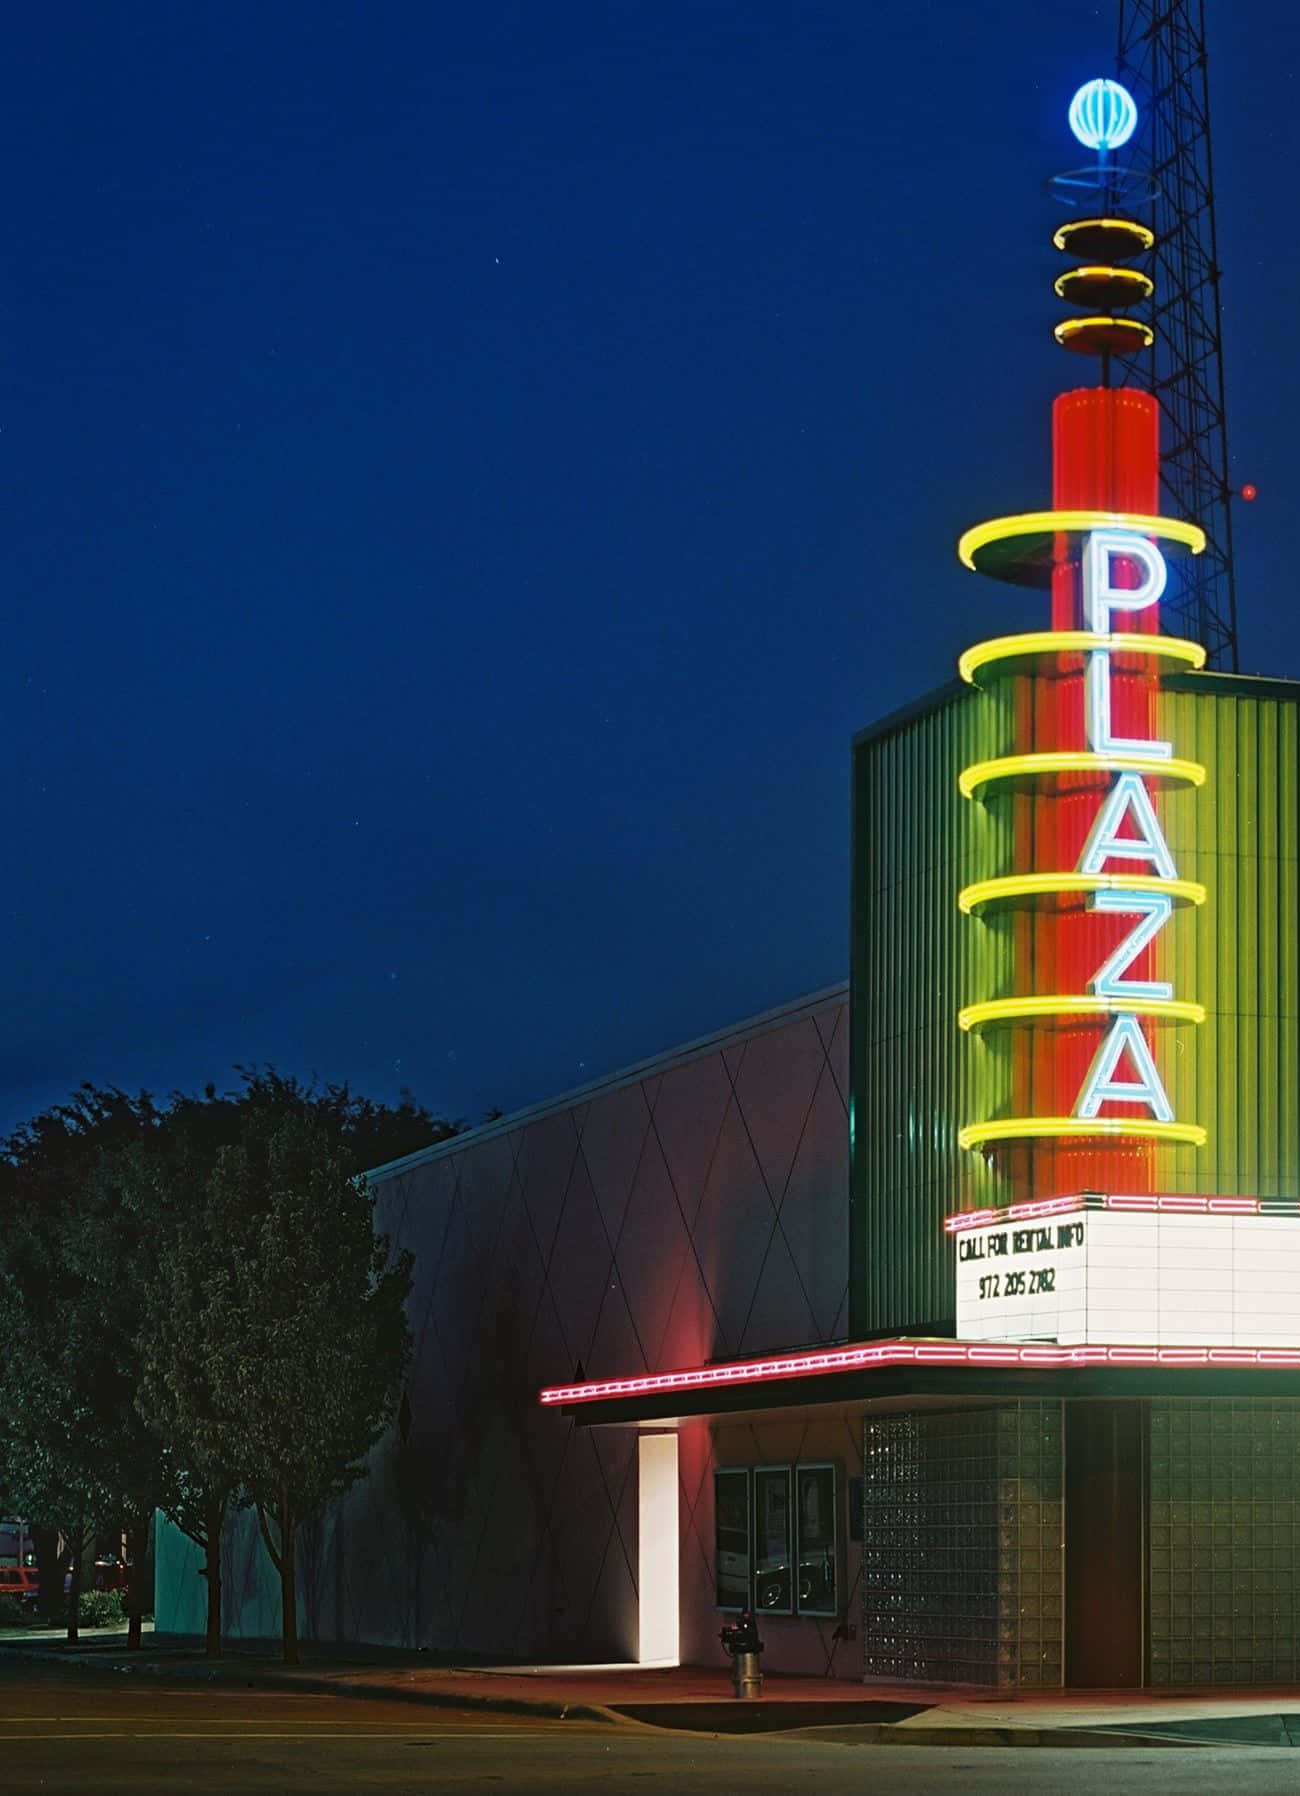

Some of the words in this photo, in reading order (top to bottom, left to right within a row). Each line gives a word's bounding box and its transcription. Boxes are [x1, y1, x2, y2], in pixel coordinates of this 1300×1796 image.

[1078, 530, 1178, 1123] PLAZA
[959, 1236, 985, 1262] CALL
[988, 1231, 1008, 1257] FOR
[1012, 1226, 1055, 1254] RENTAL
[1057, 1222, 1084, 1249] INFO
[979, 1273, 1000, 1300] 972
[1004, 1271, 1026, 1296] 205
[1028, 1267, 1055, 1294] 2782
